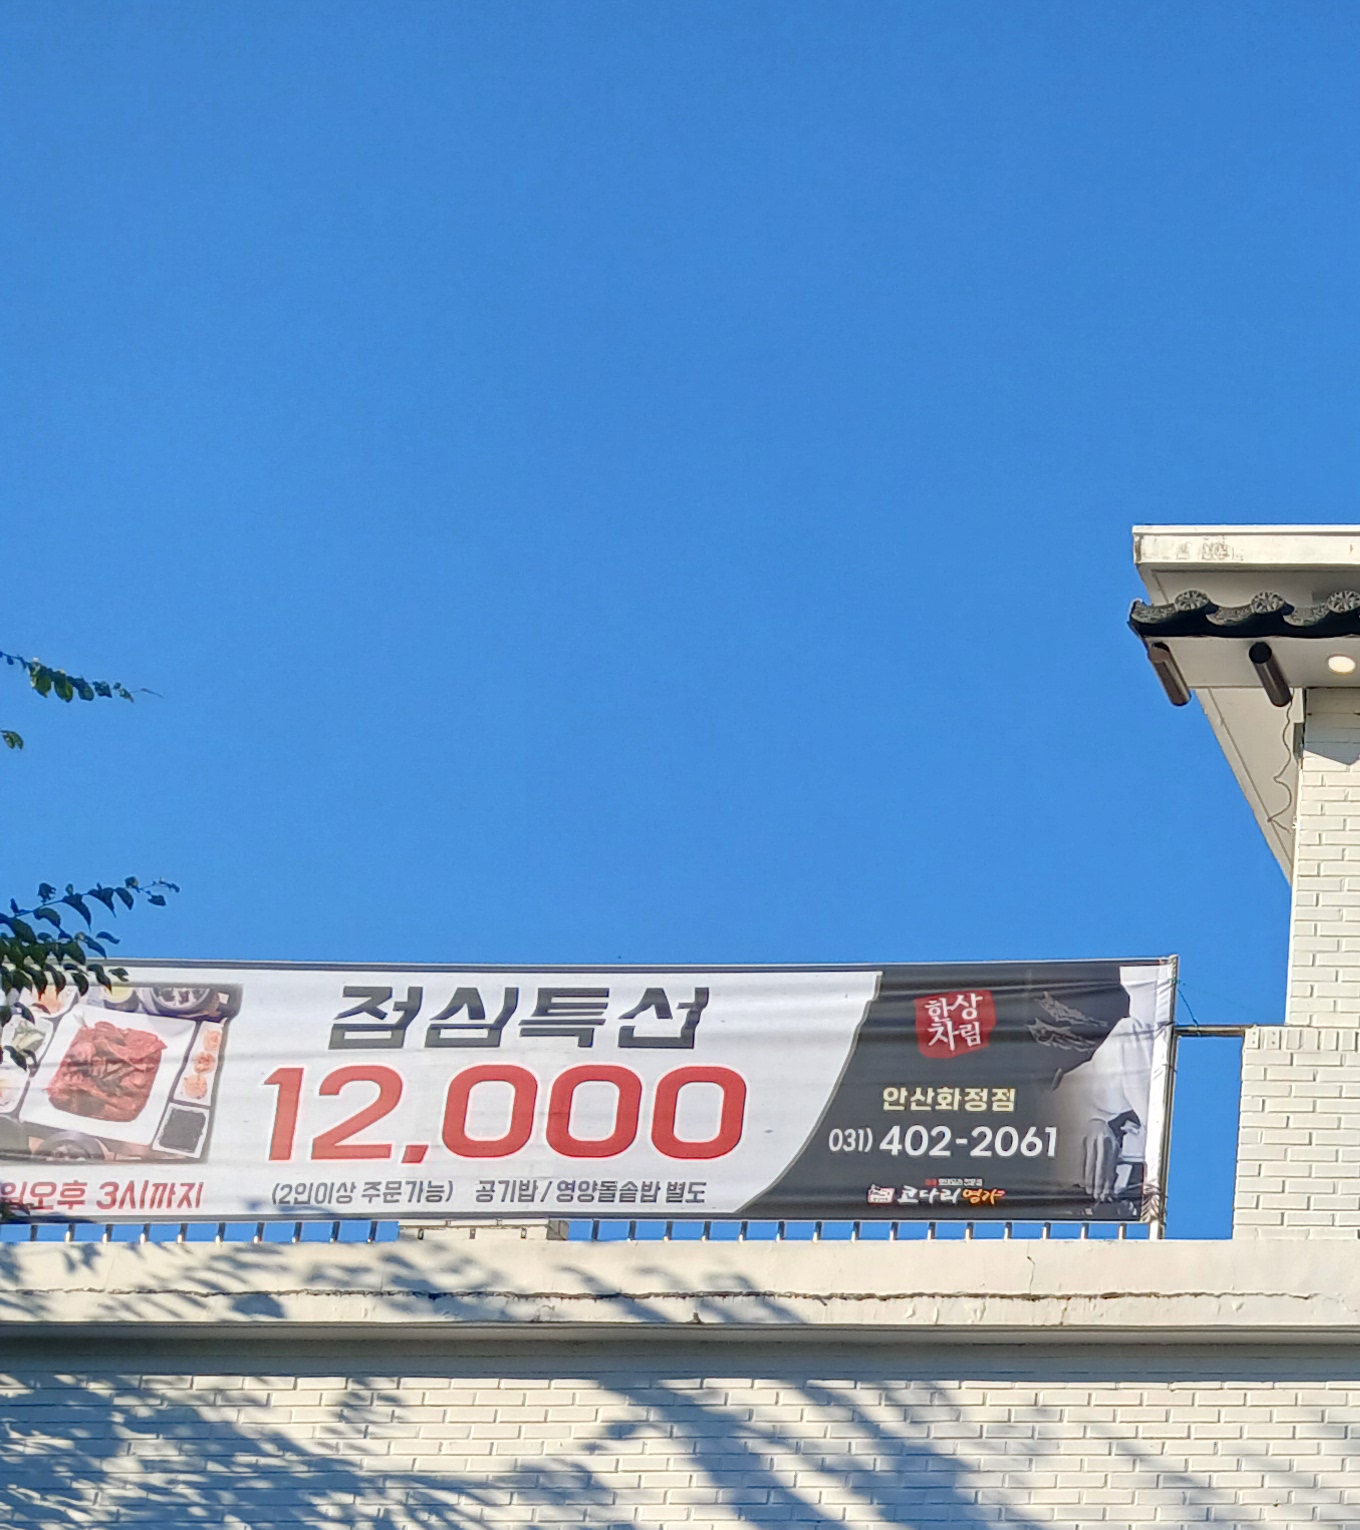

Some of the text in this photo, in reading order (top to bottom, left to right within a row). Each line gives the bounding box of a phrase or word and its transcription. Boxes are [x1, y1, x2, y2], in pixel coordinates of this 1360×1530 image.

[327, 985, 709, 1050] 점심특선
[263, 1064, 747, 1163] 12,000
[882, 1087, 1017, 1112] 안산화정점
[828, 1124, 1058, 1158] 031) 402-2061
[96, 1180, 204, 1210] 3시까지
[271, 1182, 357, 1206] (2인이상
[361, 1180, 454, 1205] 주문가능)
[665, 1181, 708, 1204] 별도
